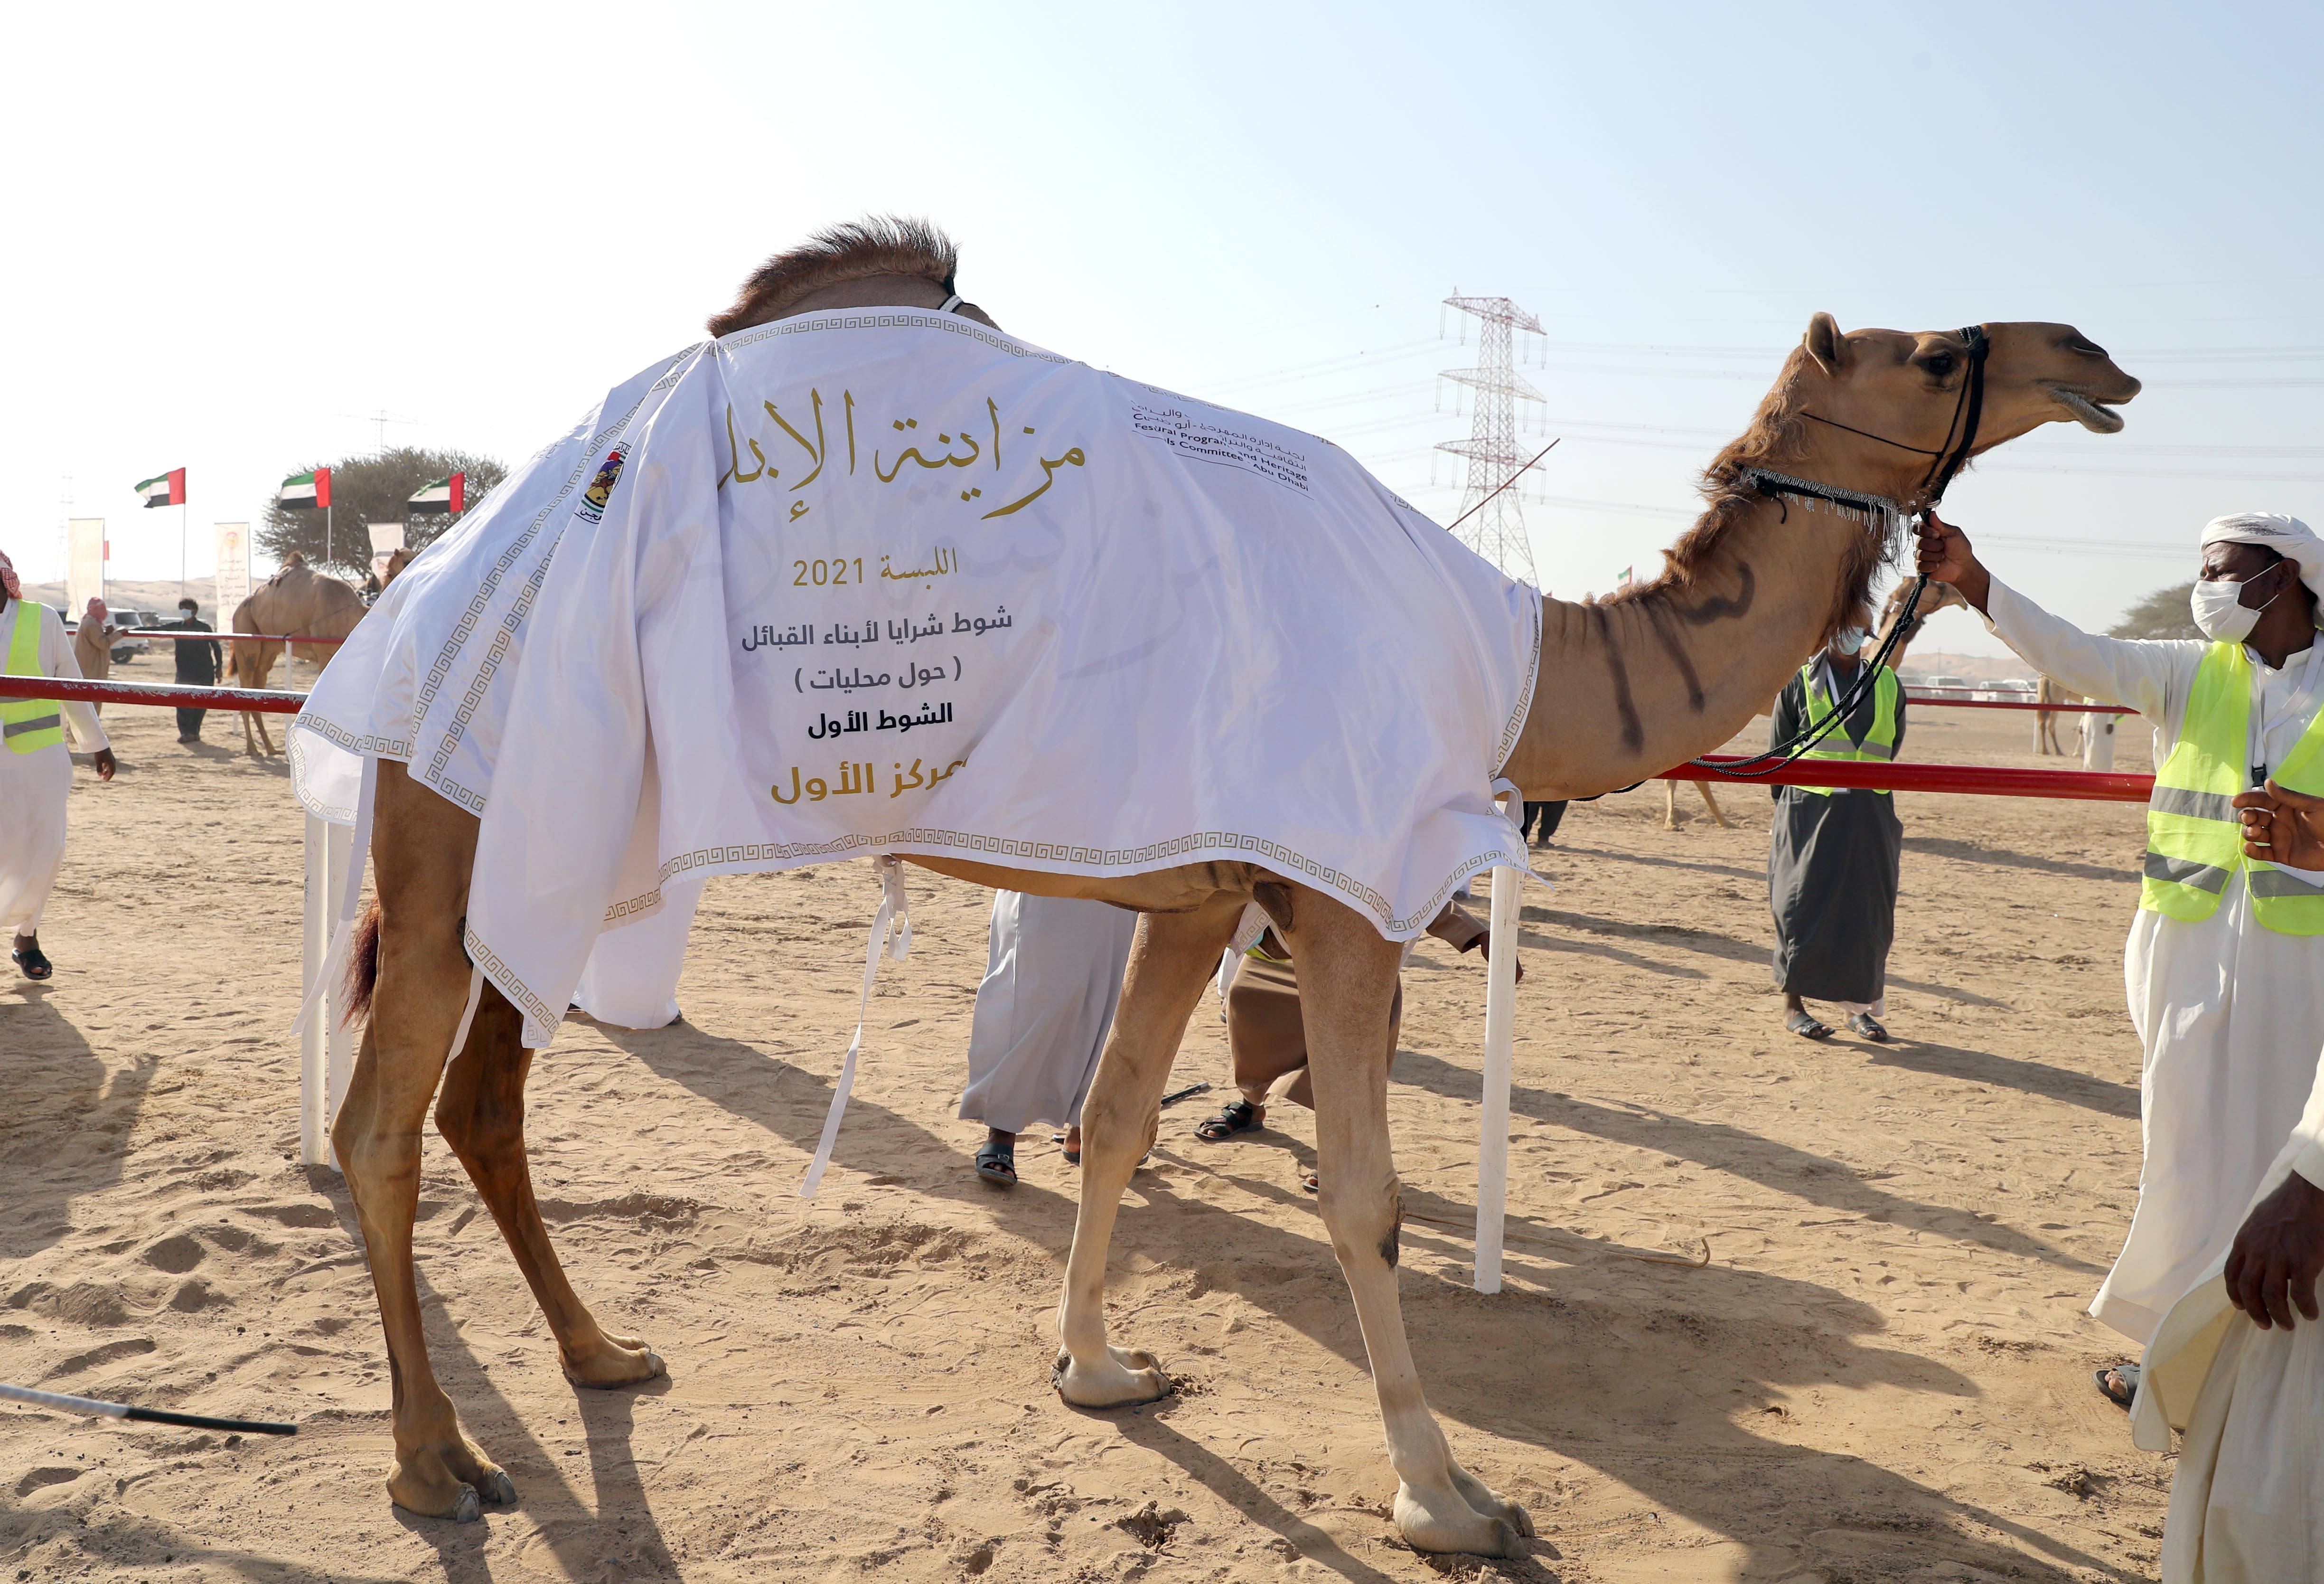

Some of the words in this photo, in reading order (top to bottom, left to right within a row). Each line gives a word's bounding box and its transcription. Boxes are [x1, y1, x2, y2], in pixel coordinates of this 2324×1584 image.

[1179, 441, 1244, 462] Committee
[1253, 463, 1274, 476] Abu
[1278, 472, 1309, 491] Dhabi
[1261, 457, 1308, 481] Heritage
[793, 557, 863, 586] 2021
[823, 620, 879, 650] لأبناء
[888, 613, 943, 645] شرايا
[951, 604, 1012, 636] شوط
[741, 624, 814, 652] القبائل
[808, 710, 868, 739] الأول
[876, 702, 953, 733] الشوط
[771, 760, 874, 804] الأول
